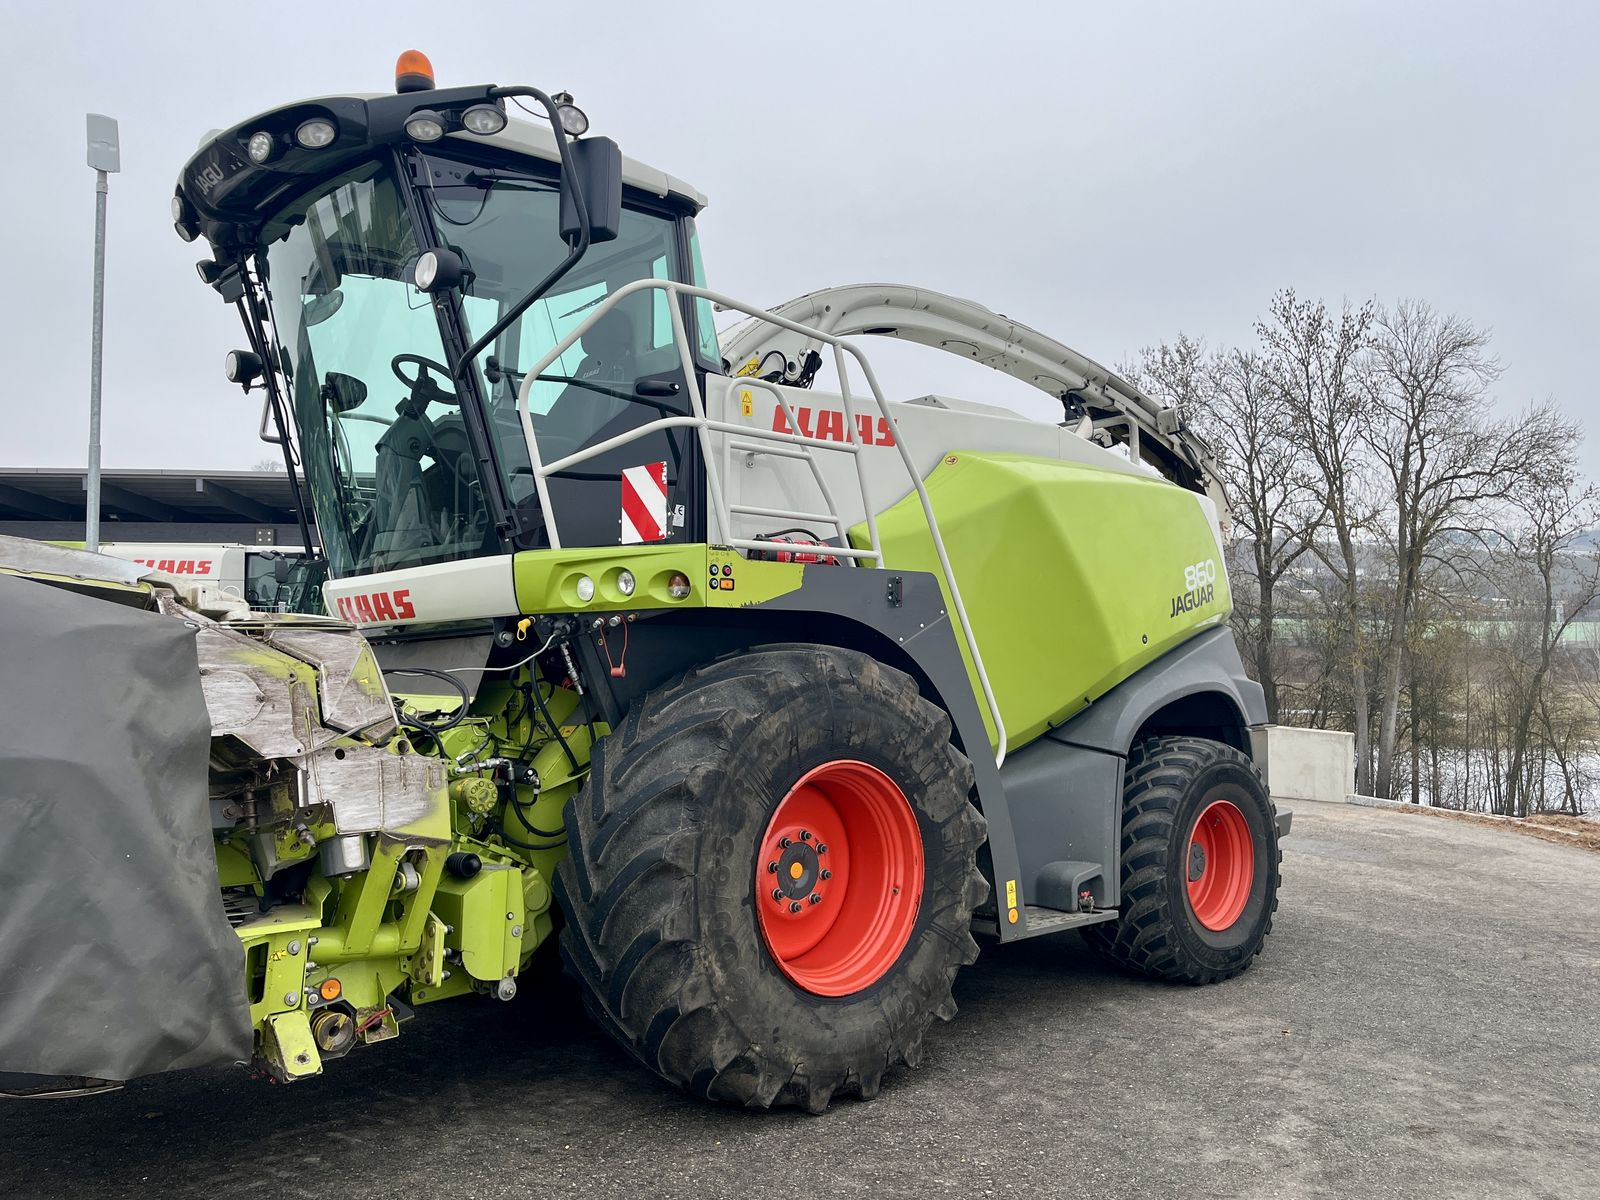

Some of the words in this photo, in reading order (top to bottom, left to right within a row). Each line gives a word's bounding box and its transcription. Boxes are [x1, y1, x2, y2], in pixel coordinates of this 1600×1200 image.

[772, 404, 898, 447] CLAAS
[133, 559, 212, 575] AAS
[1184, 558, 1216, 591] 860
[337, 589, 416, 624] CLAAS
[1170, 583, 1214, 618] JAGUAR
